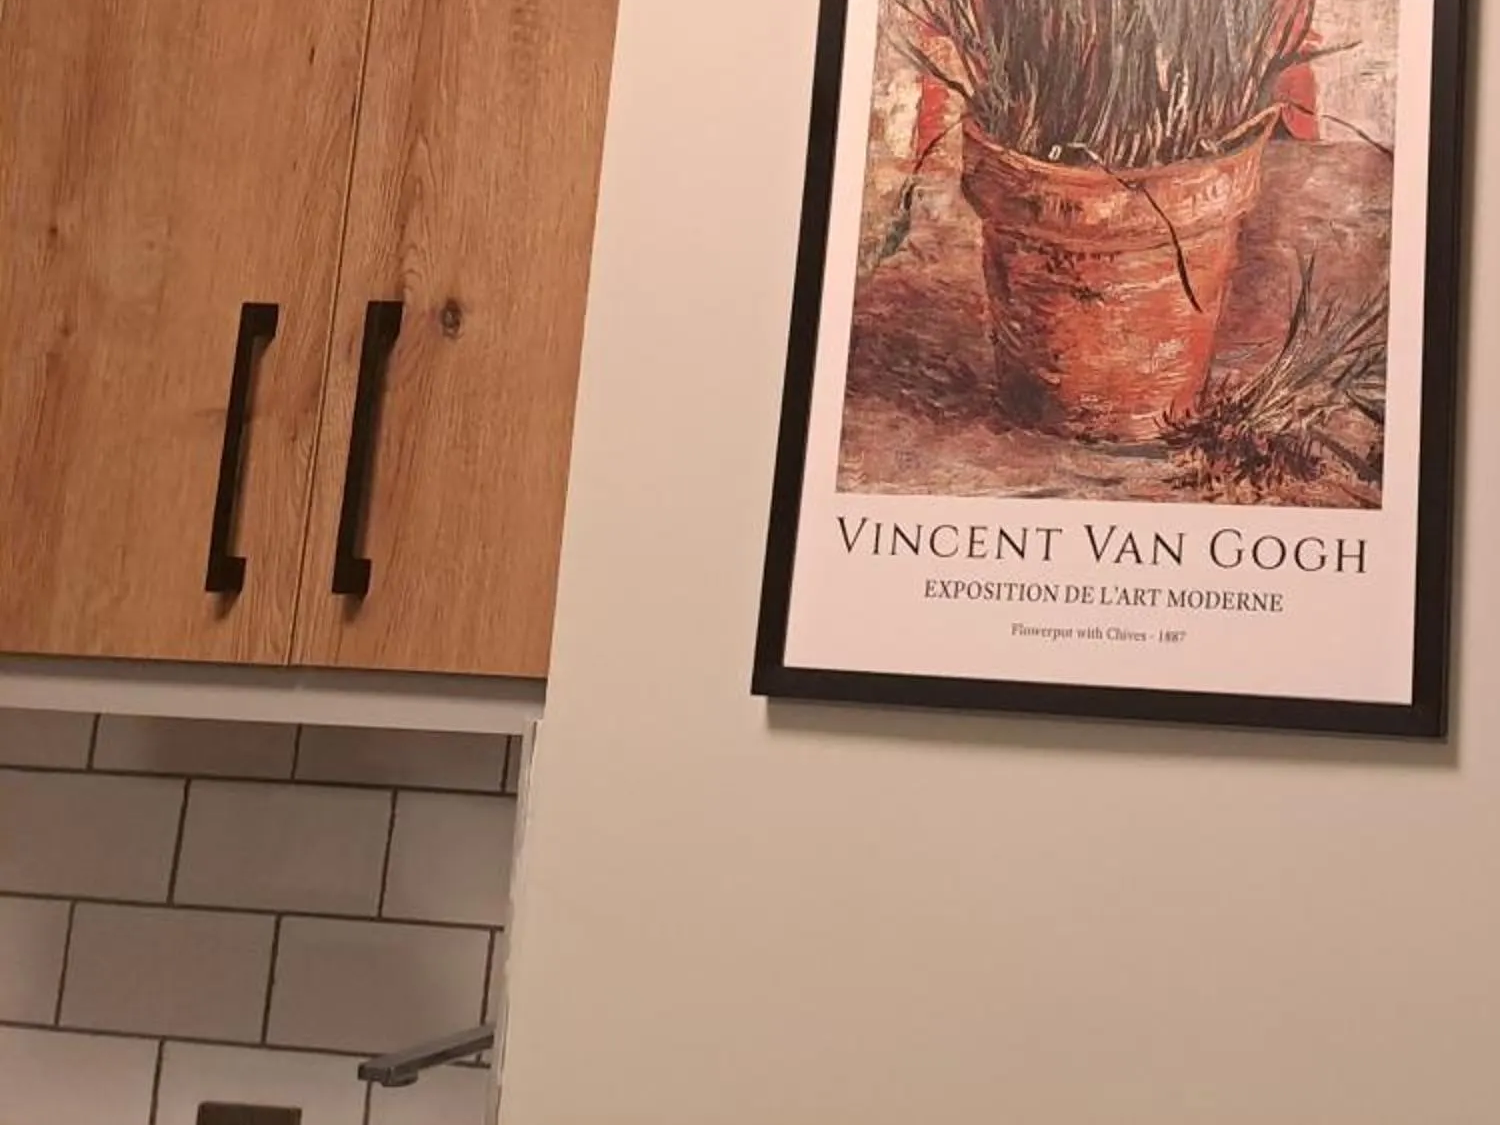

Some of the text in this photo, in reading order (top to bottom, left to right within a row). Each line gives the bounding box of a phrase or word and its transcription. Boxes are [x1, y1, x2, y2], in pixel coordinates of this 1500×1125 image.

[836, 516, 1366, 574] VINCENT VAN GOGH
[924, 579, 1060, 603] EXPOSITION
[1064, 584, 1095, 605] DE
[1167, 588, 1283, 613] MODERNE
[1076, 626, 1104, 640] with
[1105, 626, 1147, 642] Chives
